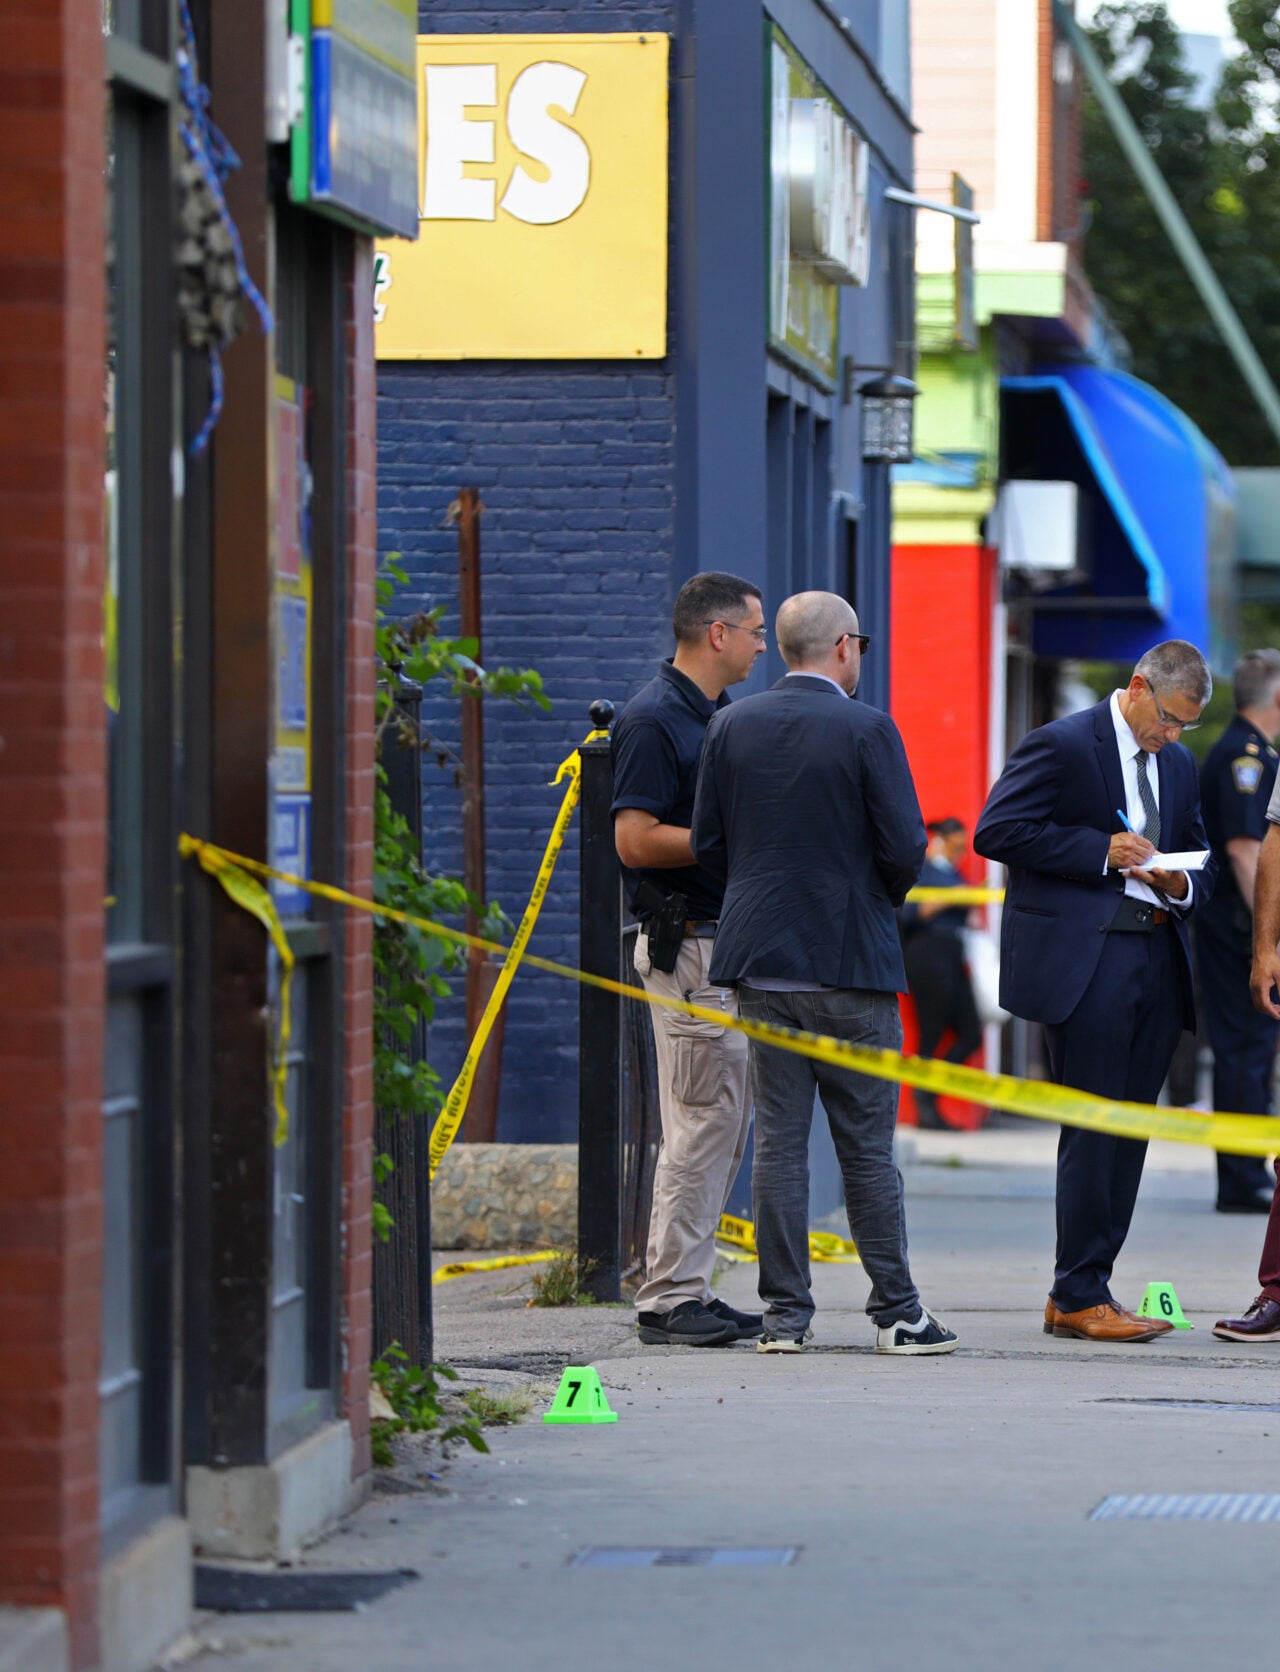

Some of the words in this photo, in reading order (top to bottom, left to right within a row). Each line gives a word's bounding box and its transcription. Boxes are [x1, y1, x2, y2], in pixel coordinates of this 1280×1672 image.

[420, 60, 591, 226] ES
[1159, 1292, 1174, 1316] 6
[566, 1381, 582, 1408] 7
